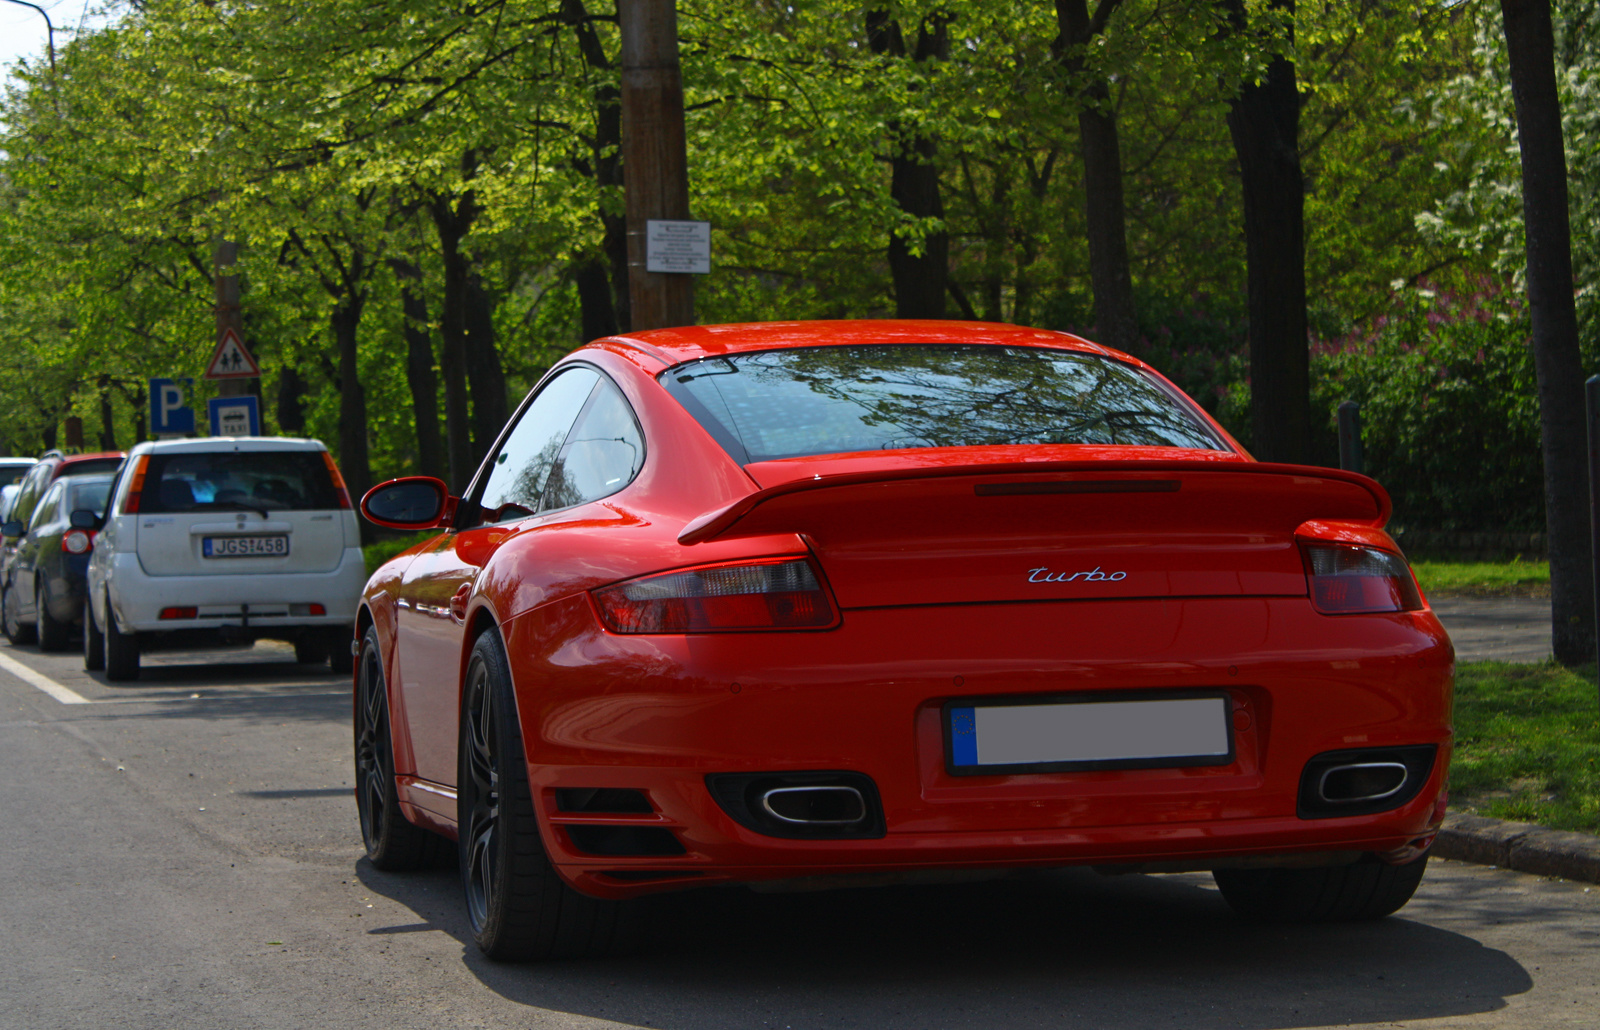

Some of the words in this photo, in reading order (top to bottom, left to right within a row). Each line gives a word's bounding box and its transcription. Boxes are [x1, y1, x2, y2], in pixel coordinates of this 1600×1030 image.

[160, 385, 184, 427] P
[223, 424, 247, 434] TAXI
[1027, 566, 1128, 583] turbo
